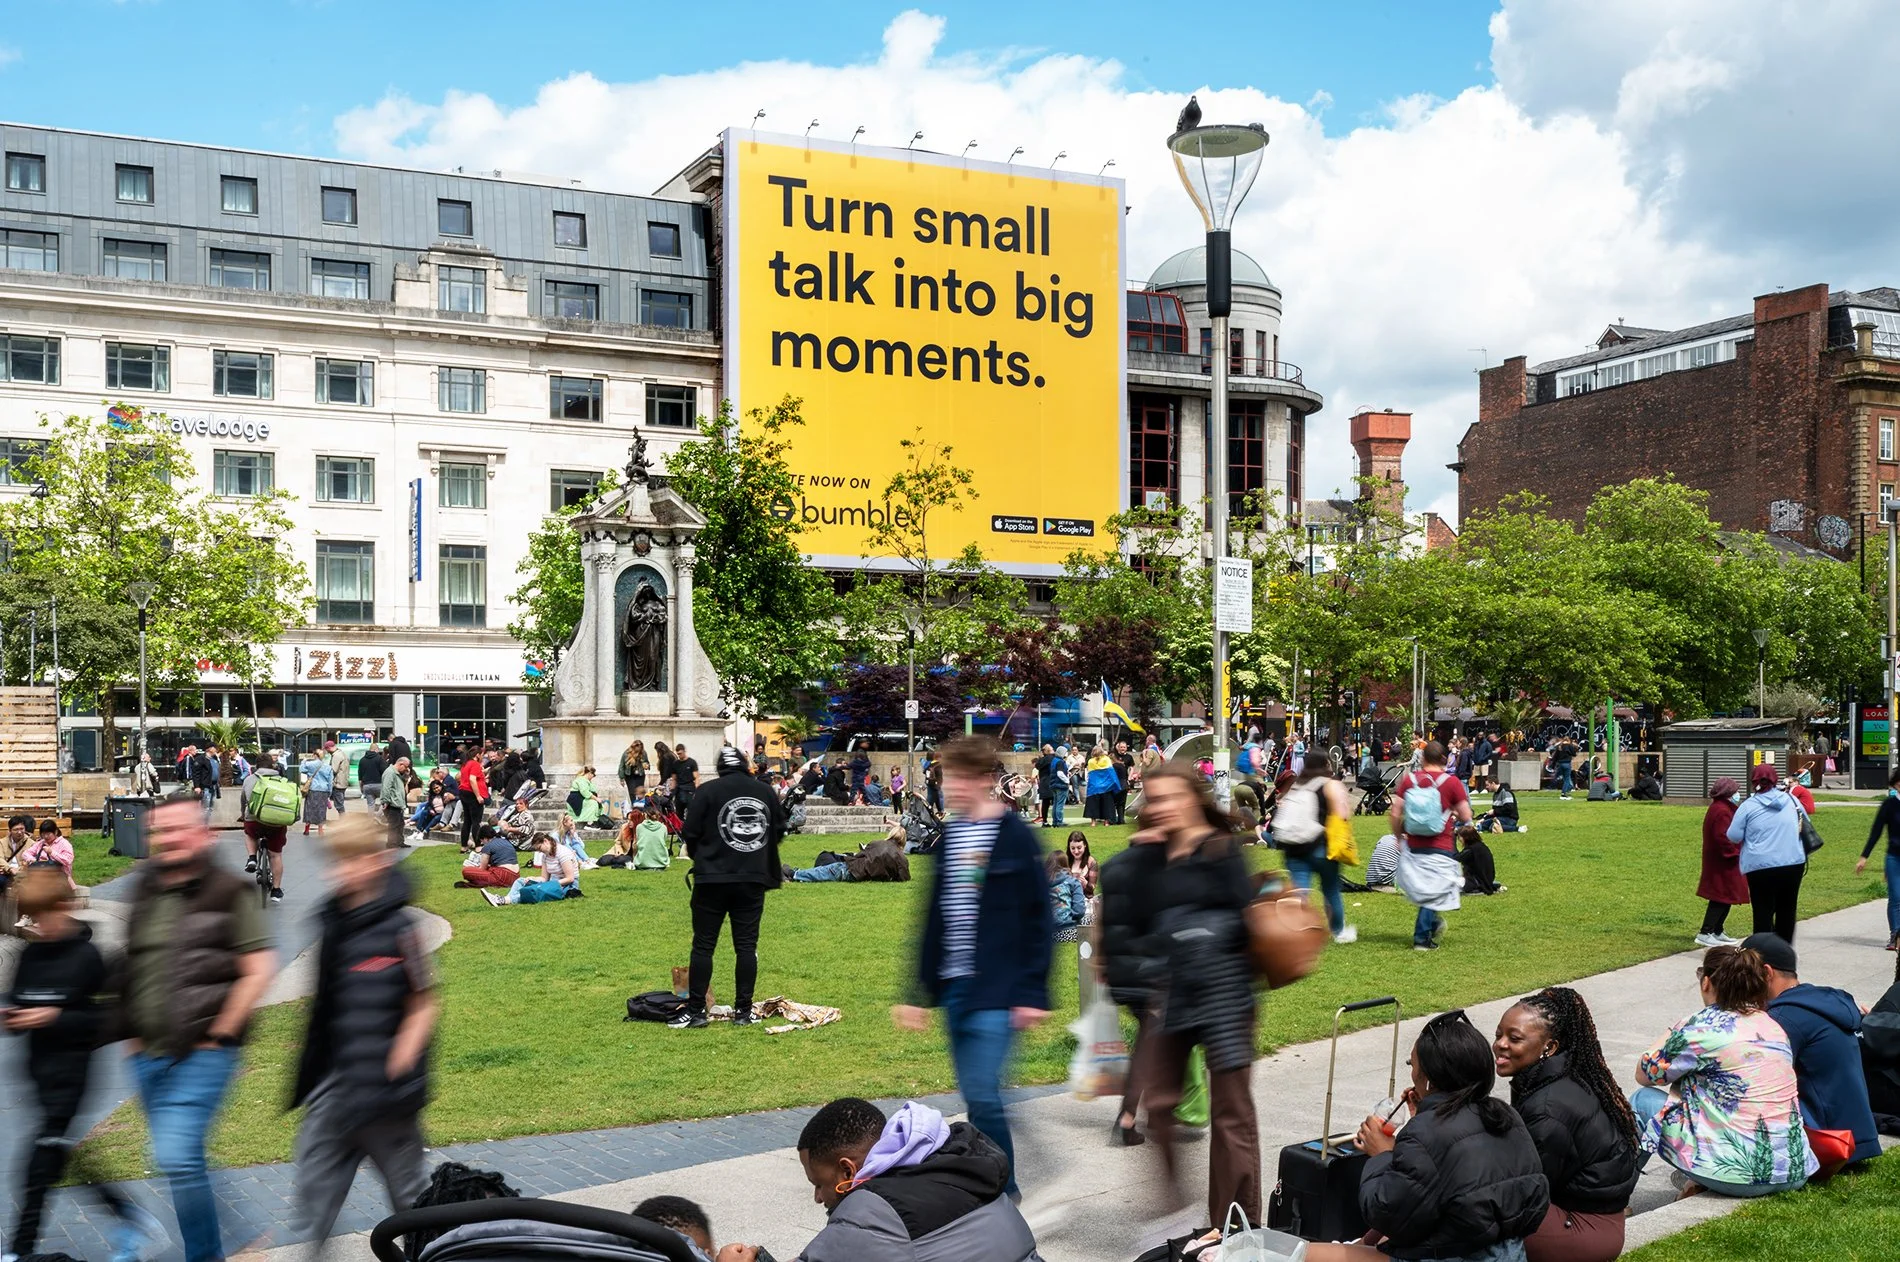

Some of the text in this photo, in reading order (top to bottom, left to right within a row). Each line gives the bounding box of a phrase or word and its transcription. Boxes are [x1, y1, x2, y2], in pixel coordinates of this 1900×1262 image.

[768, 174, 1050, 257] Turn small
[768, 250, 1094, 339] talk into big
[771, 330, 1046, 389] moments.
[809, 475, 846, 488] NOW
[849, 477, 871, 489] ON
[801, 495, 910, 528] bumble
[1004, 523, 1035, 531] App Store
[1058, 525, 1092, 535] Google Play
[1221, 566, 1248, 579] NOTICE
[306, 650, 399, 681] Zizzi
[465, 673, 500, 681] ITALIAN
